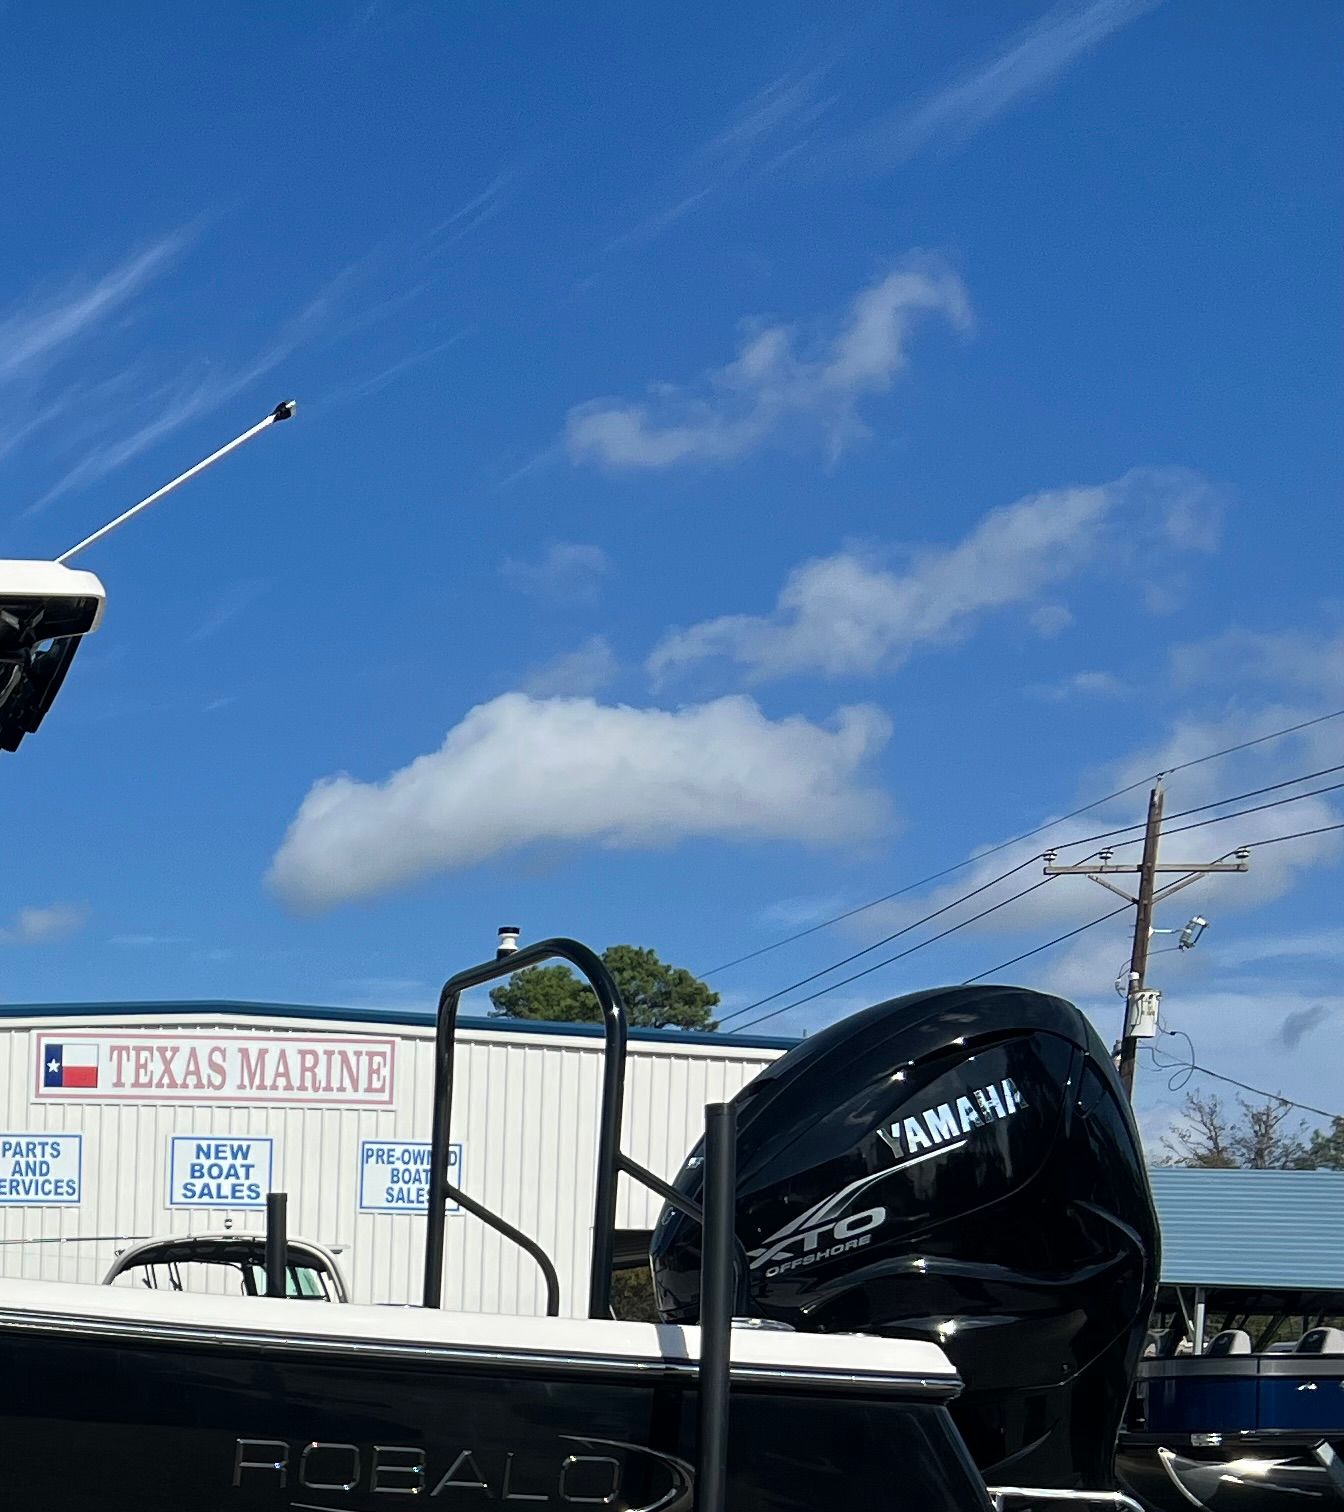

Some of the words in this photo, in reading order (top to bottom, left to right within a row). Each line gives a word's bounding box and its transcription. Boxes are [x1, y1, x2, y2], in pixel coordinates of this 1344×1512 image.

[109, 1044, 228, 1091] TEXAS
[237, 1047, 388, 1094] MARINE
[876, 1077, 1029, 1159] YAMAHA
[1, 1141, 61, 1159] PARTS
[195, 1143, 252, 1161] NEW
[365, 1148, 458, 1167] PRE-OWD
[11, 1160, 50, 1178] AND
[189, 1163, 255, 1181] BOAT
[182, 1182, 262, 1201] SALES
[385, 1187, 430, 1204] SALE
[765, 1234, 872, 1278] OFFSHORE
[231, 1437, 621, 1505] ROBALO
